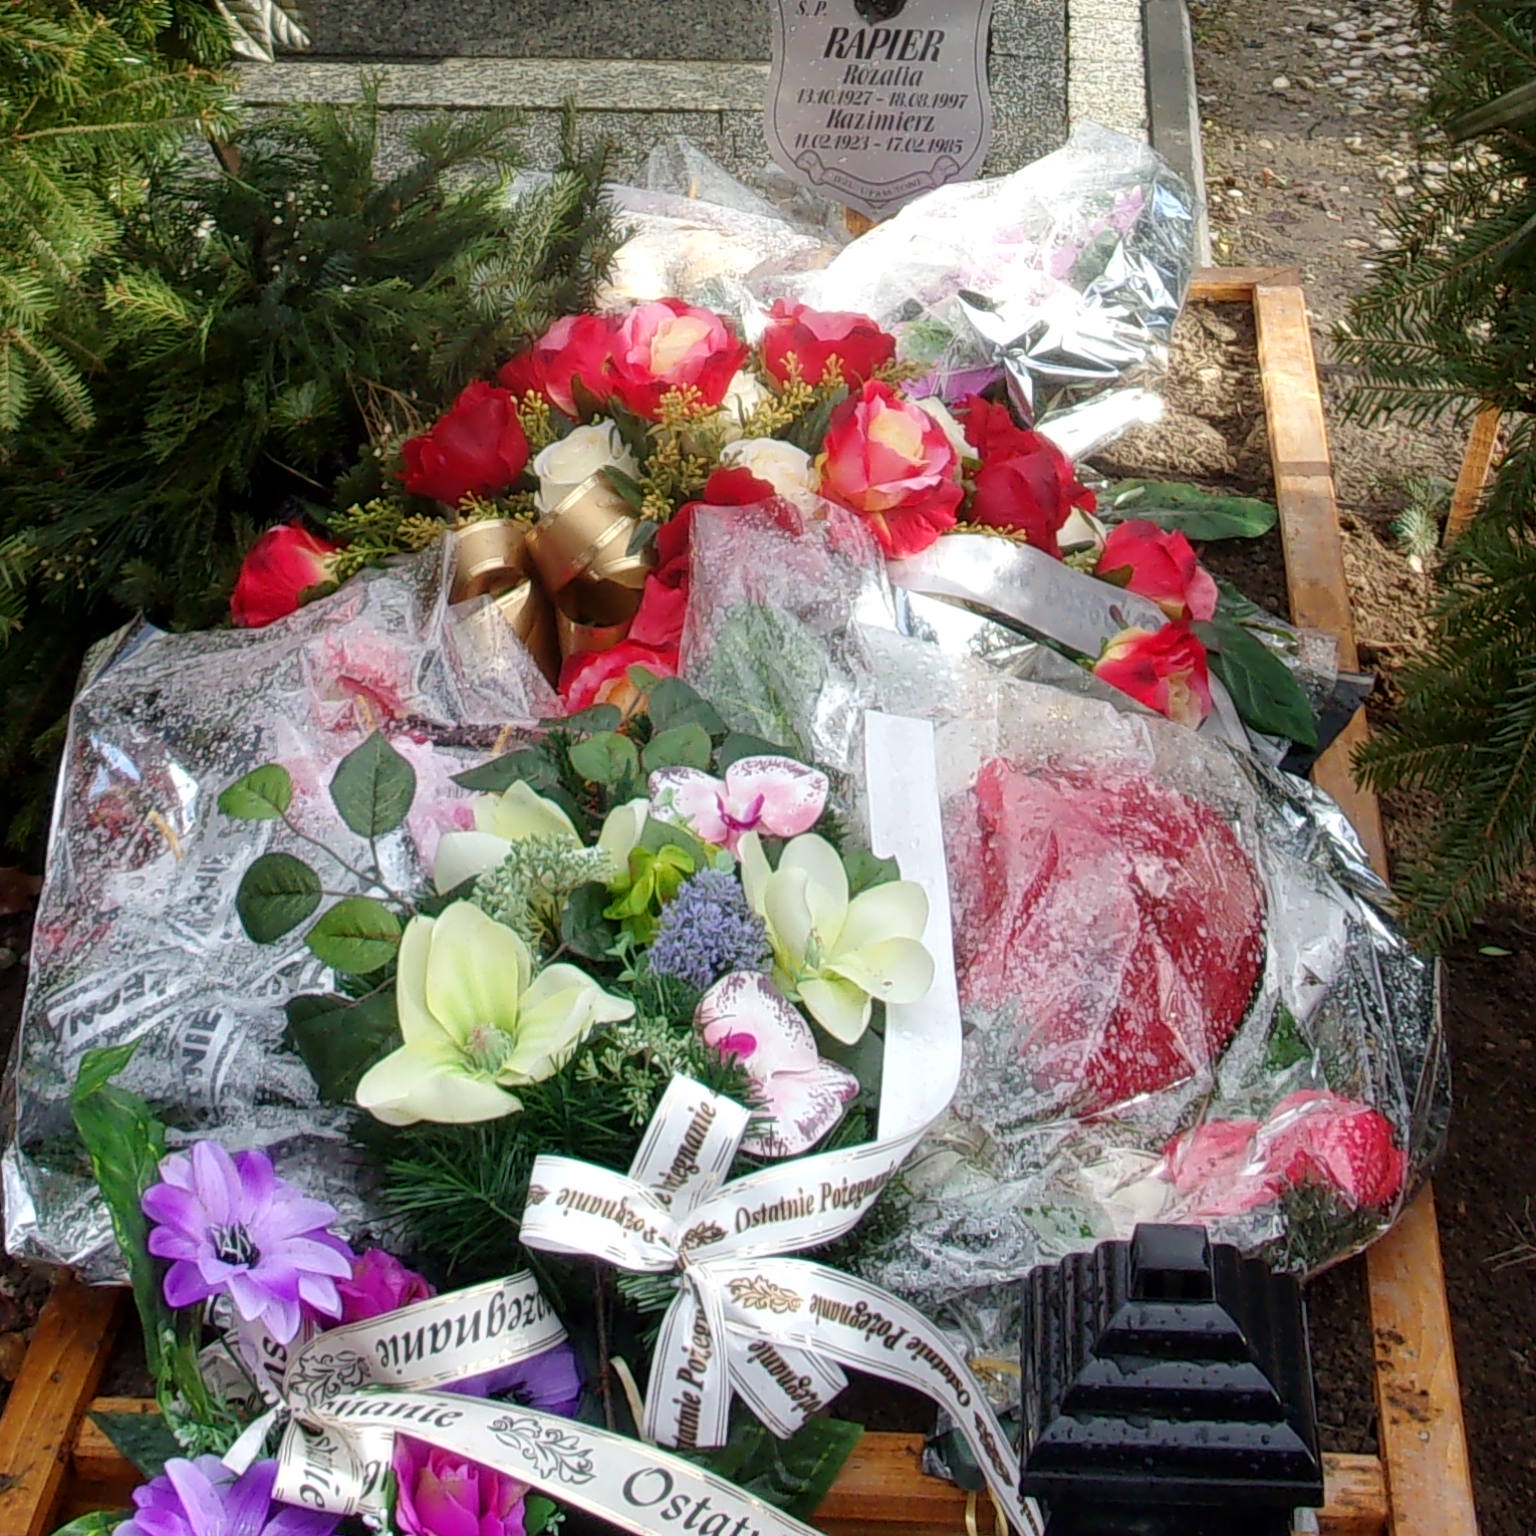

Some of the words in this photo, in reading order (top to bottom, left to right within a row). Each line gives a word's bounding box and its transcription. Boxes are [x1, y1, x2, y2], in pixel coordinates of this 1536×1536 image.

[823, 27, 945, 62] RAPIER
[842, 65, 924, 87] Rozalia
[888, 92, 968, 110] 18.08.1997
[826, 109, 936, 133] Kazimierz
[886, 137, 964, 154] 17.02.1985
[736, 1187, 814, 1233] Ostatnie
[809, 1292, 910, 1350] Pożegnanie
[905, 1335, 971, 1407] Ostatnie
